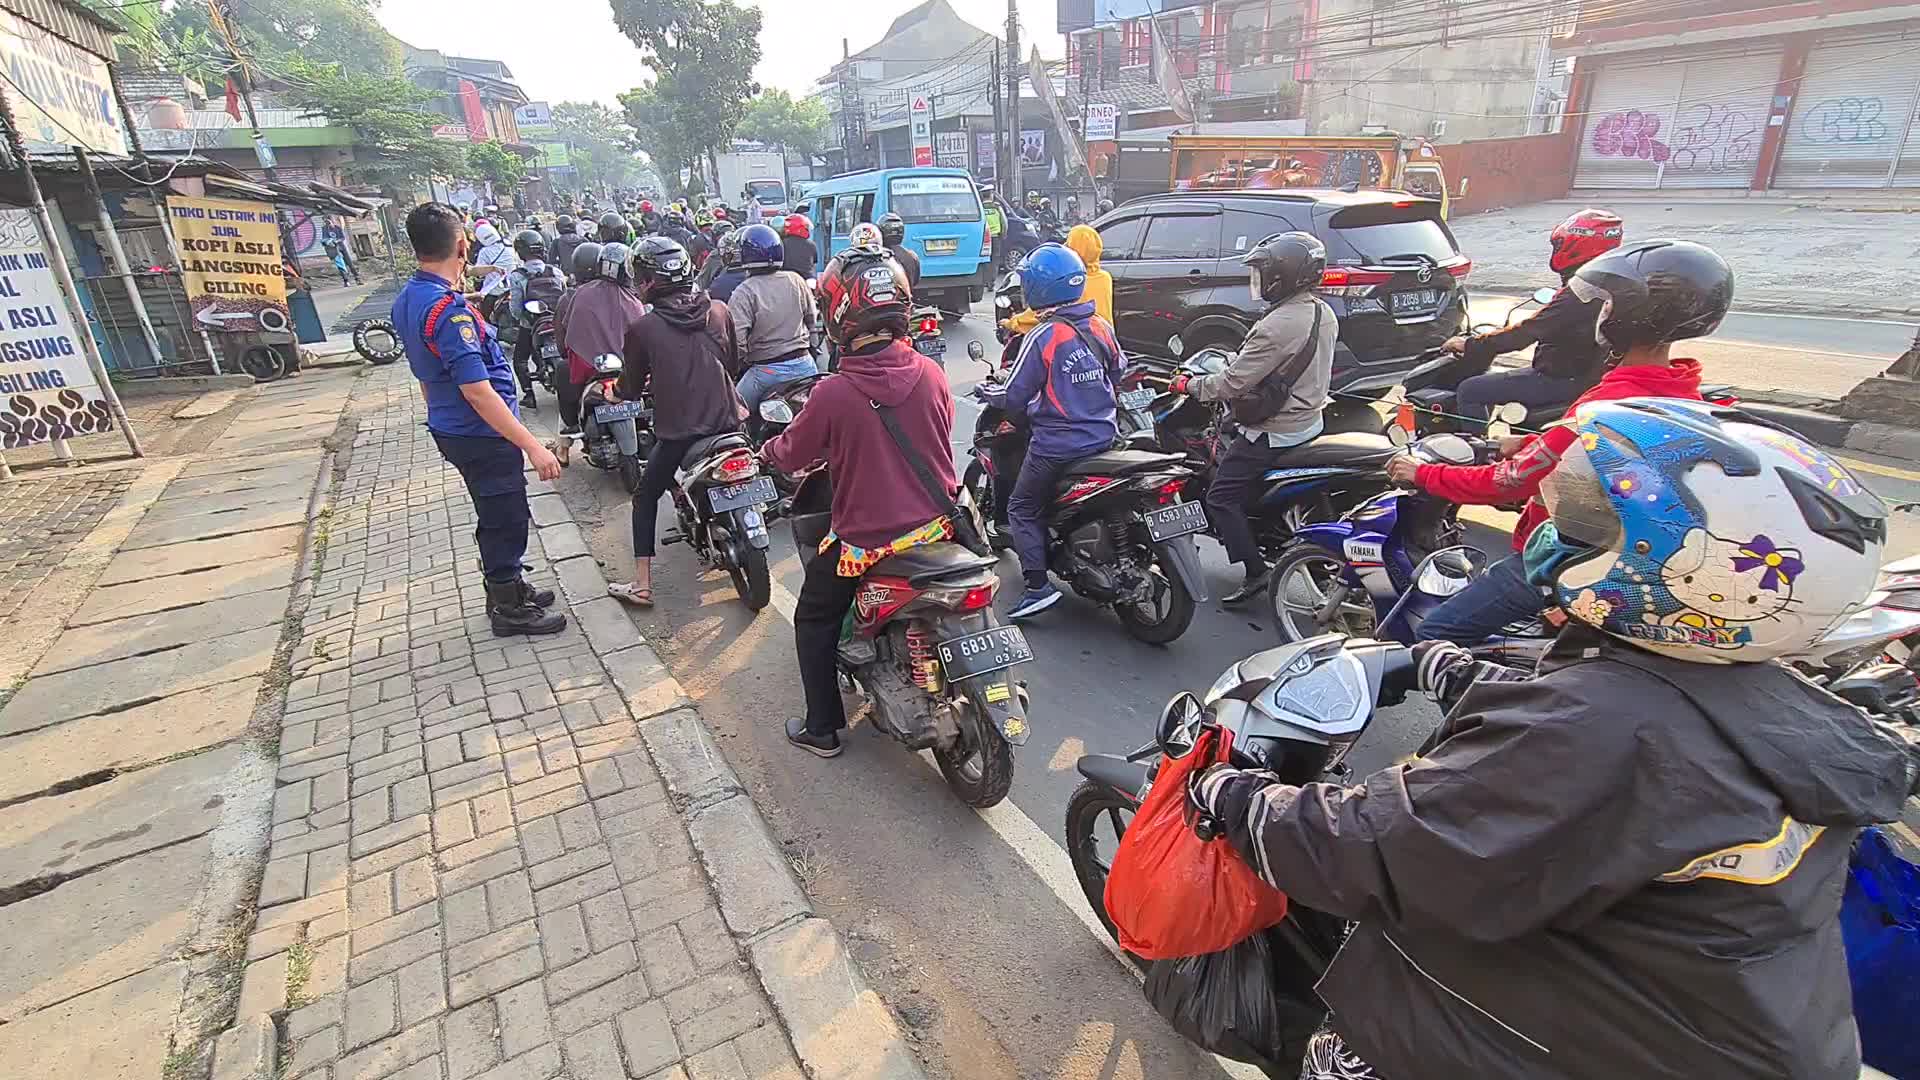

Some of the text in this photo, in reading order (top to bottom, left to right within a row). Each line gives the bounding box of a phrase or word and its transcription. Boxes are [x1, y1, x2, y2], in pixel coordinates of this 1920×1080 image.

[171, 206, 275, 224] TOKO LISTRIK INI
[211, 225, 243, 238] JUAL
[181, 238, 275, 256] KOPI ASLI
[24, 252, 49, 269] INI
[180, 259, 283, 276] LANGSUNG
[203, 281, 268, 296] GILING
[7, 305, 57, 330] ASLI
[0, 369, 66, 394] GILING
[1146, 515, 1154, 527] B
[1159, 510, 1181, 524] 4583
[1350, 545, 1377, 558] YAMAHA
[942, 647, 954, 663] B
[960, 634, 995, 657] 6831
